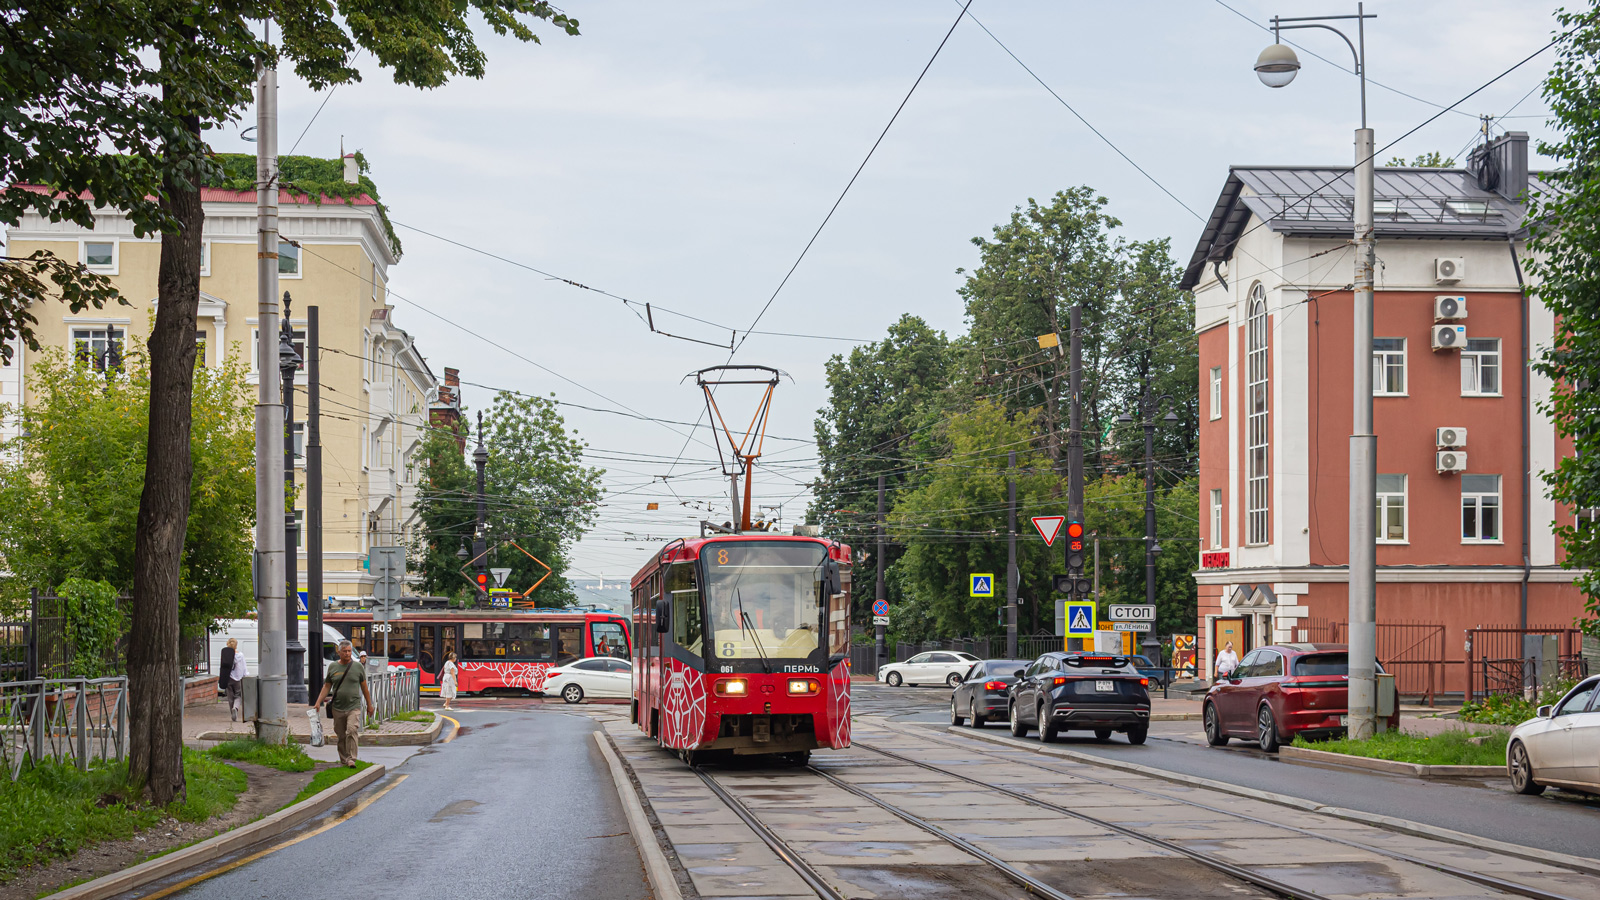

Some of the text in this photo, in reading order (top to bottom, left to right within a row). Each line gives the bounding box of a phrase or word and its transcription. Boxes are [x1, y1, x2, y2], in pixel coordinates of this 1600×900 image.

[1071, 540, 1082, 550] 26
[717, 548, 729, 565] 8
[1115, 607, 1150, 618] СТОП
[722, 642, 735, 657] 8
[720, 665, 734, 673] 061
[784, 665, 820, 673] ПЕРМЬ
